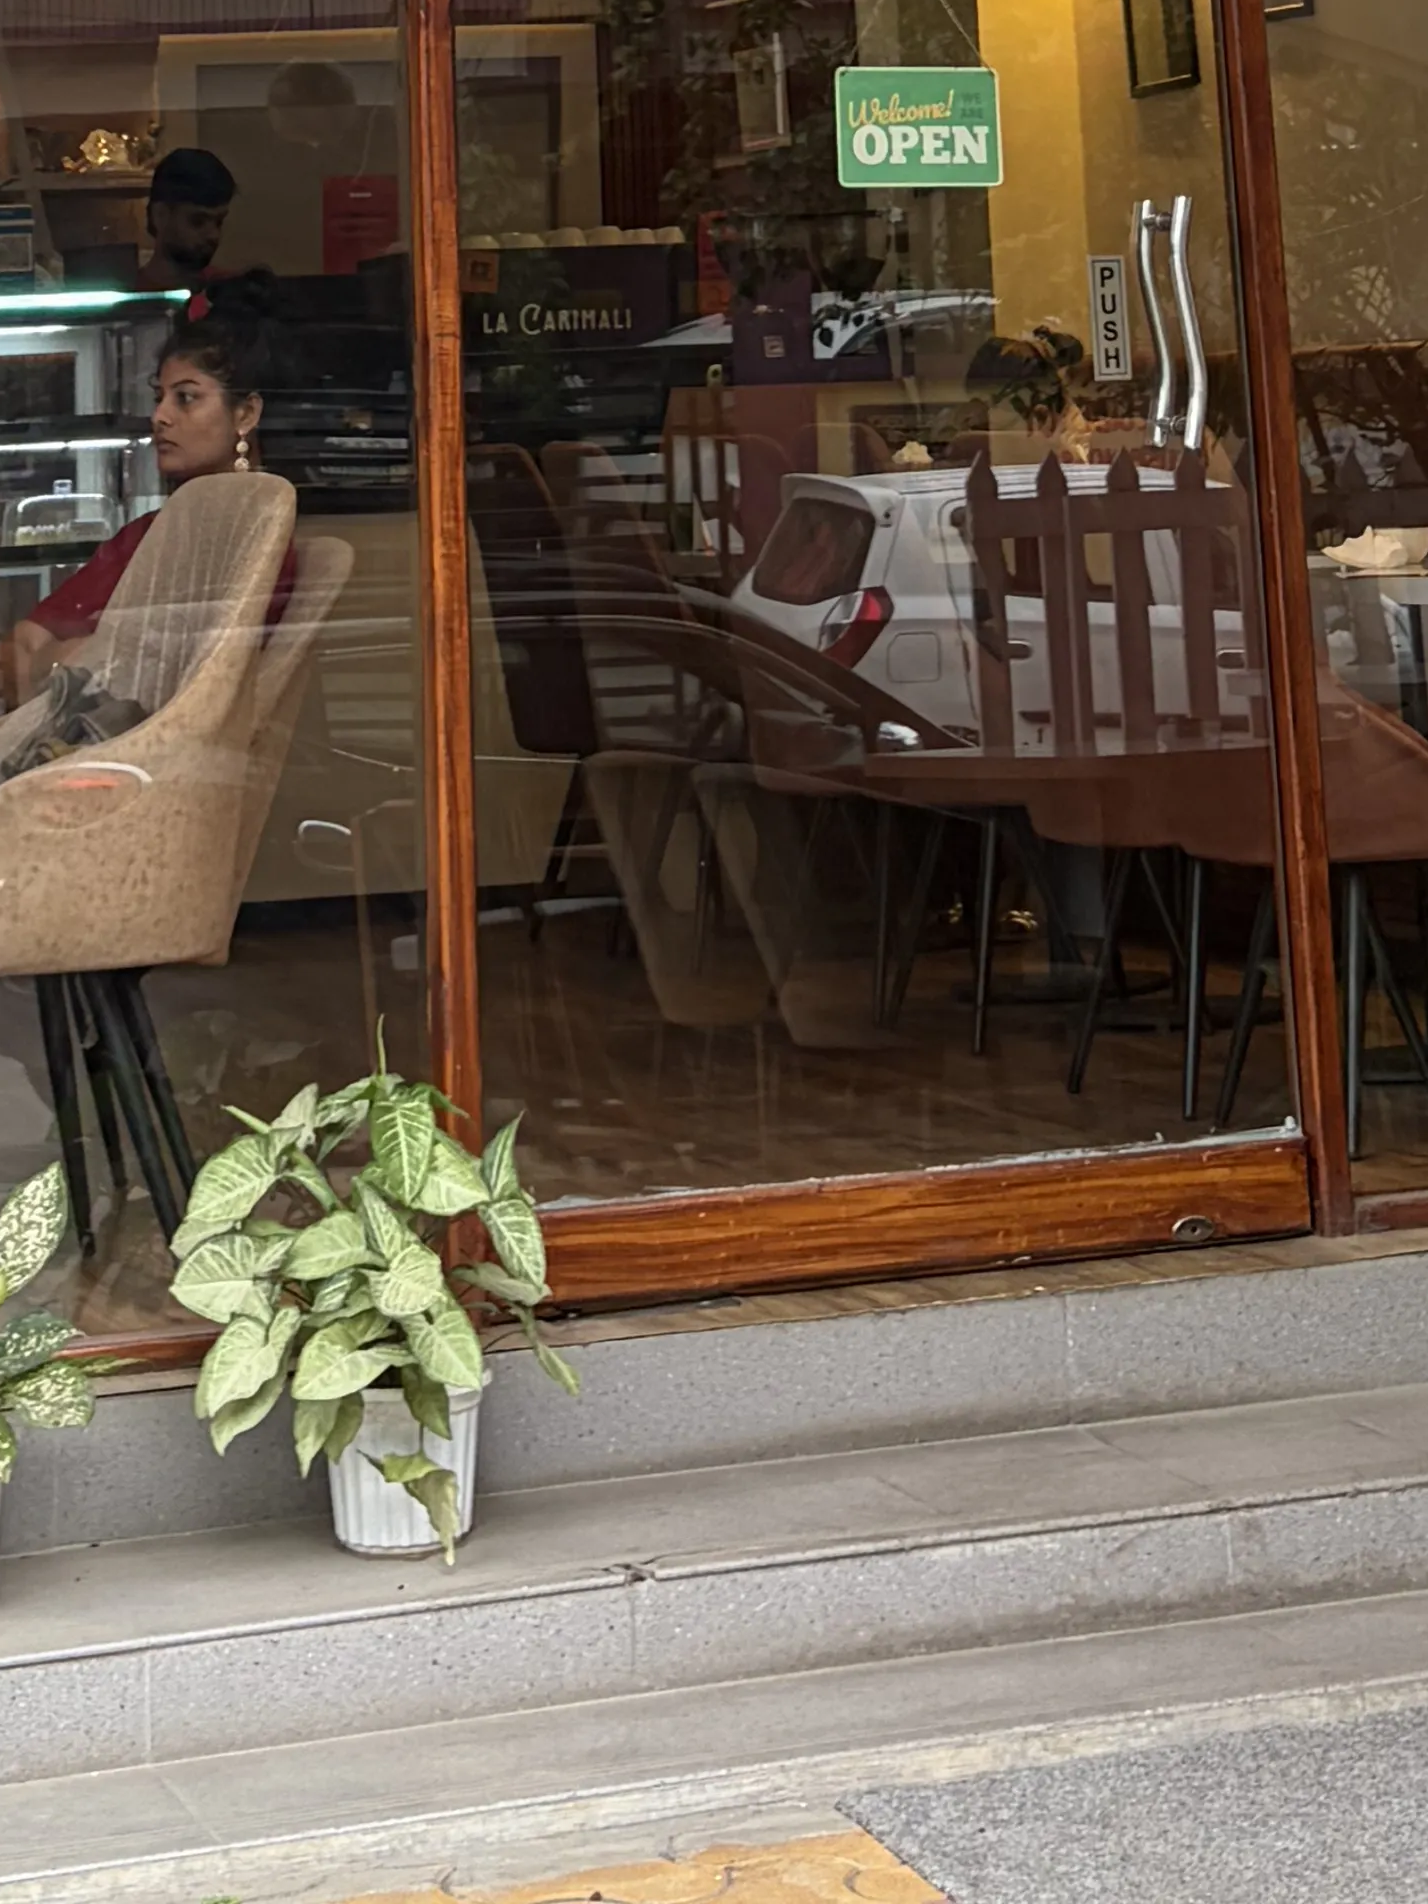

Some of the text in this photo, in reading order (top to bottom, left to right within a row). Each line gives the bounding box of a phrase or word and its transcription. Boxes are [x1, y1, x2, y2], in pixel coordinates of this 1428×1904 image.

[848, 89, 954, 128] Welcome!
[960, 108, 984, 120] ARE
[961, 93, 982, 105] WE
[852, 124, 989, 165] OPEN
[483, 311, 509, 334] LA
[1099, 267, 1120, 369] PUSH
